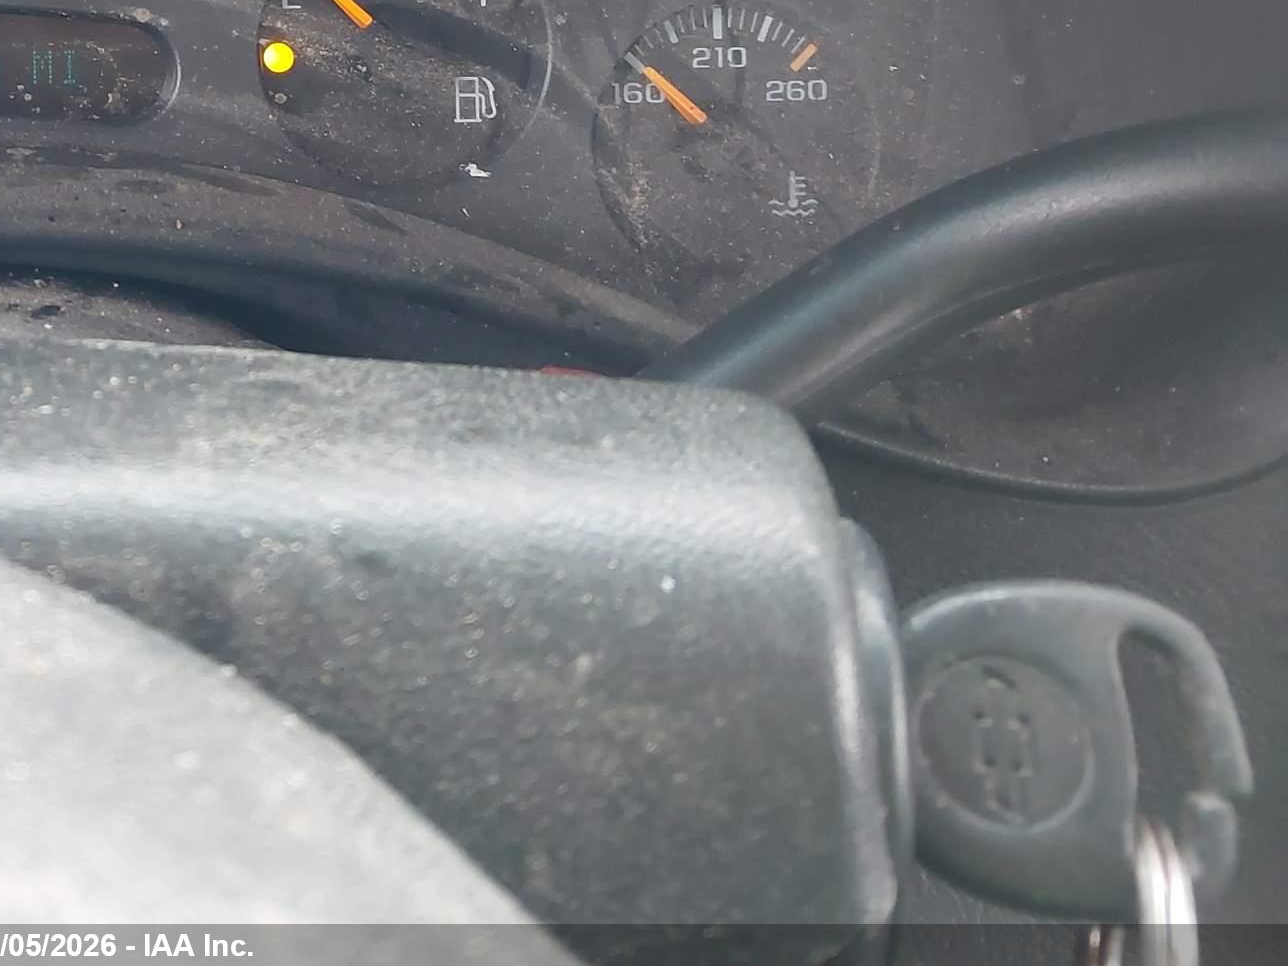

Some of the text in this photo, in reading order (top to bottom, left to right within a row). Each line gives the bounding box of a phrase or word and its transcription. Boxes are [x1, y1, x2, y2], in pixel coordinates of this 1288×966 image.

[32, 49, 76, 85] MI
[692, 47, 748, 68] 210
[612, 82, 666, 105] 160
[765, 79, 828, 102] 260
